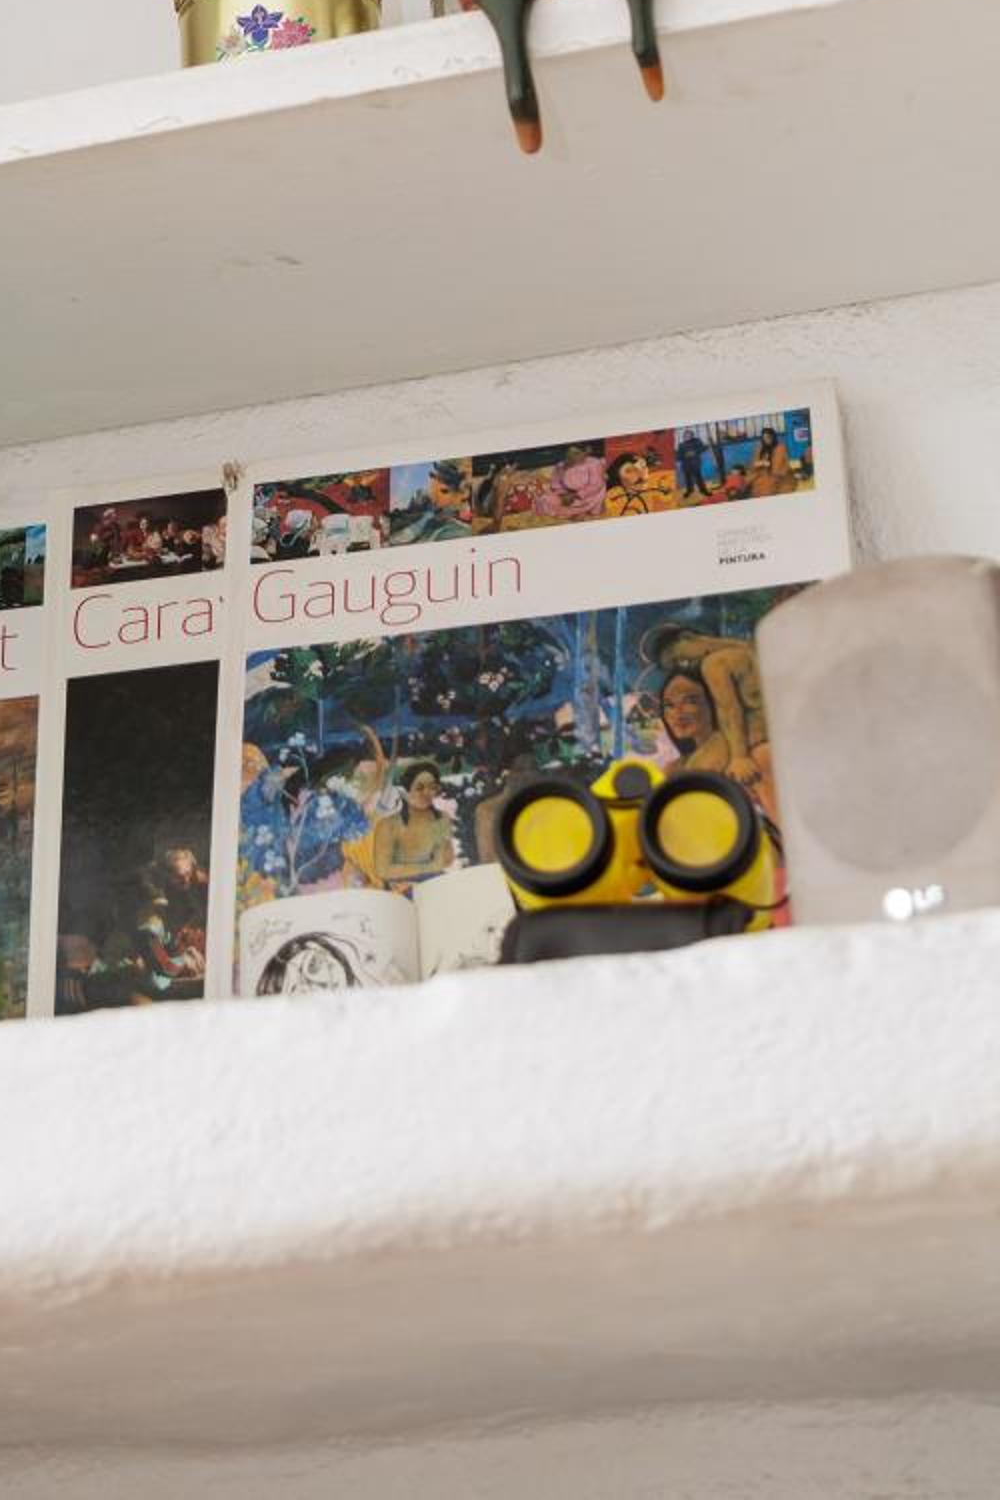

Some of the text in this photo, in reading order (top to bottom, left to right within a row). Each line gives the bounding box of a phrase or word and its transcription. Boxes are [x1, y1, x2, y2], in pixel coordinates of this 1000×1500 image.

[718, 552, 767, 565] PINTURA
[253, 547, 523, 629] Gauguin
[73, 593, 225, 651] Cara
